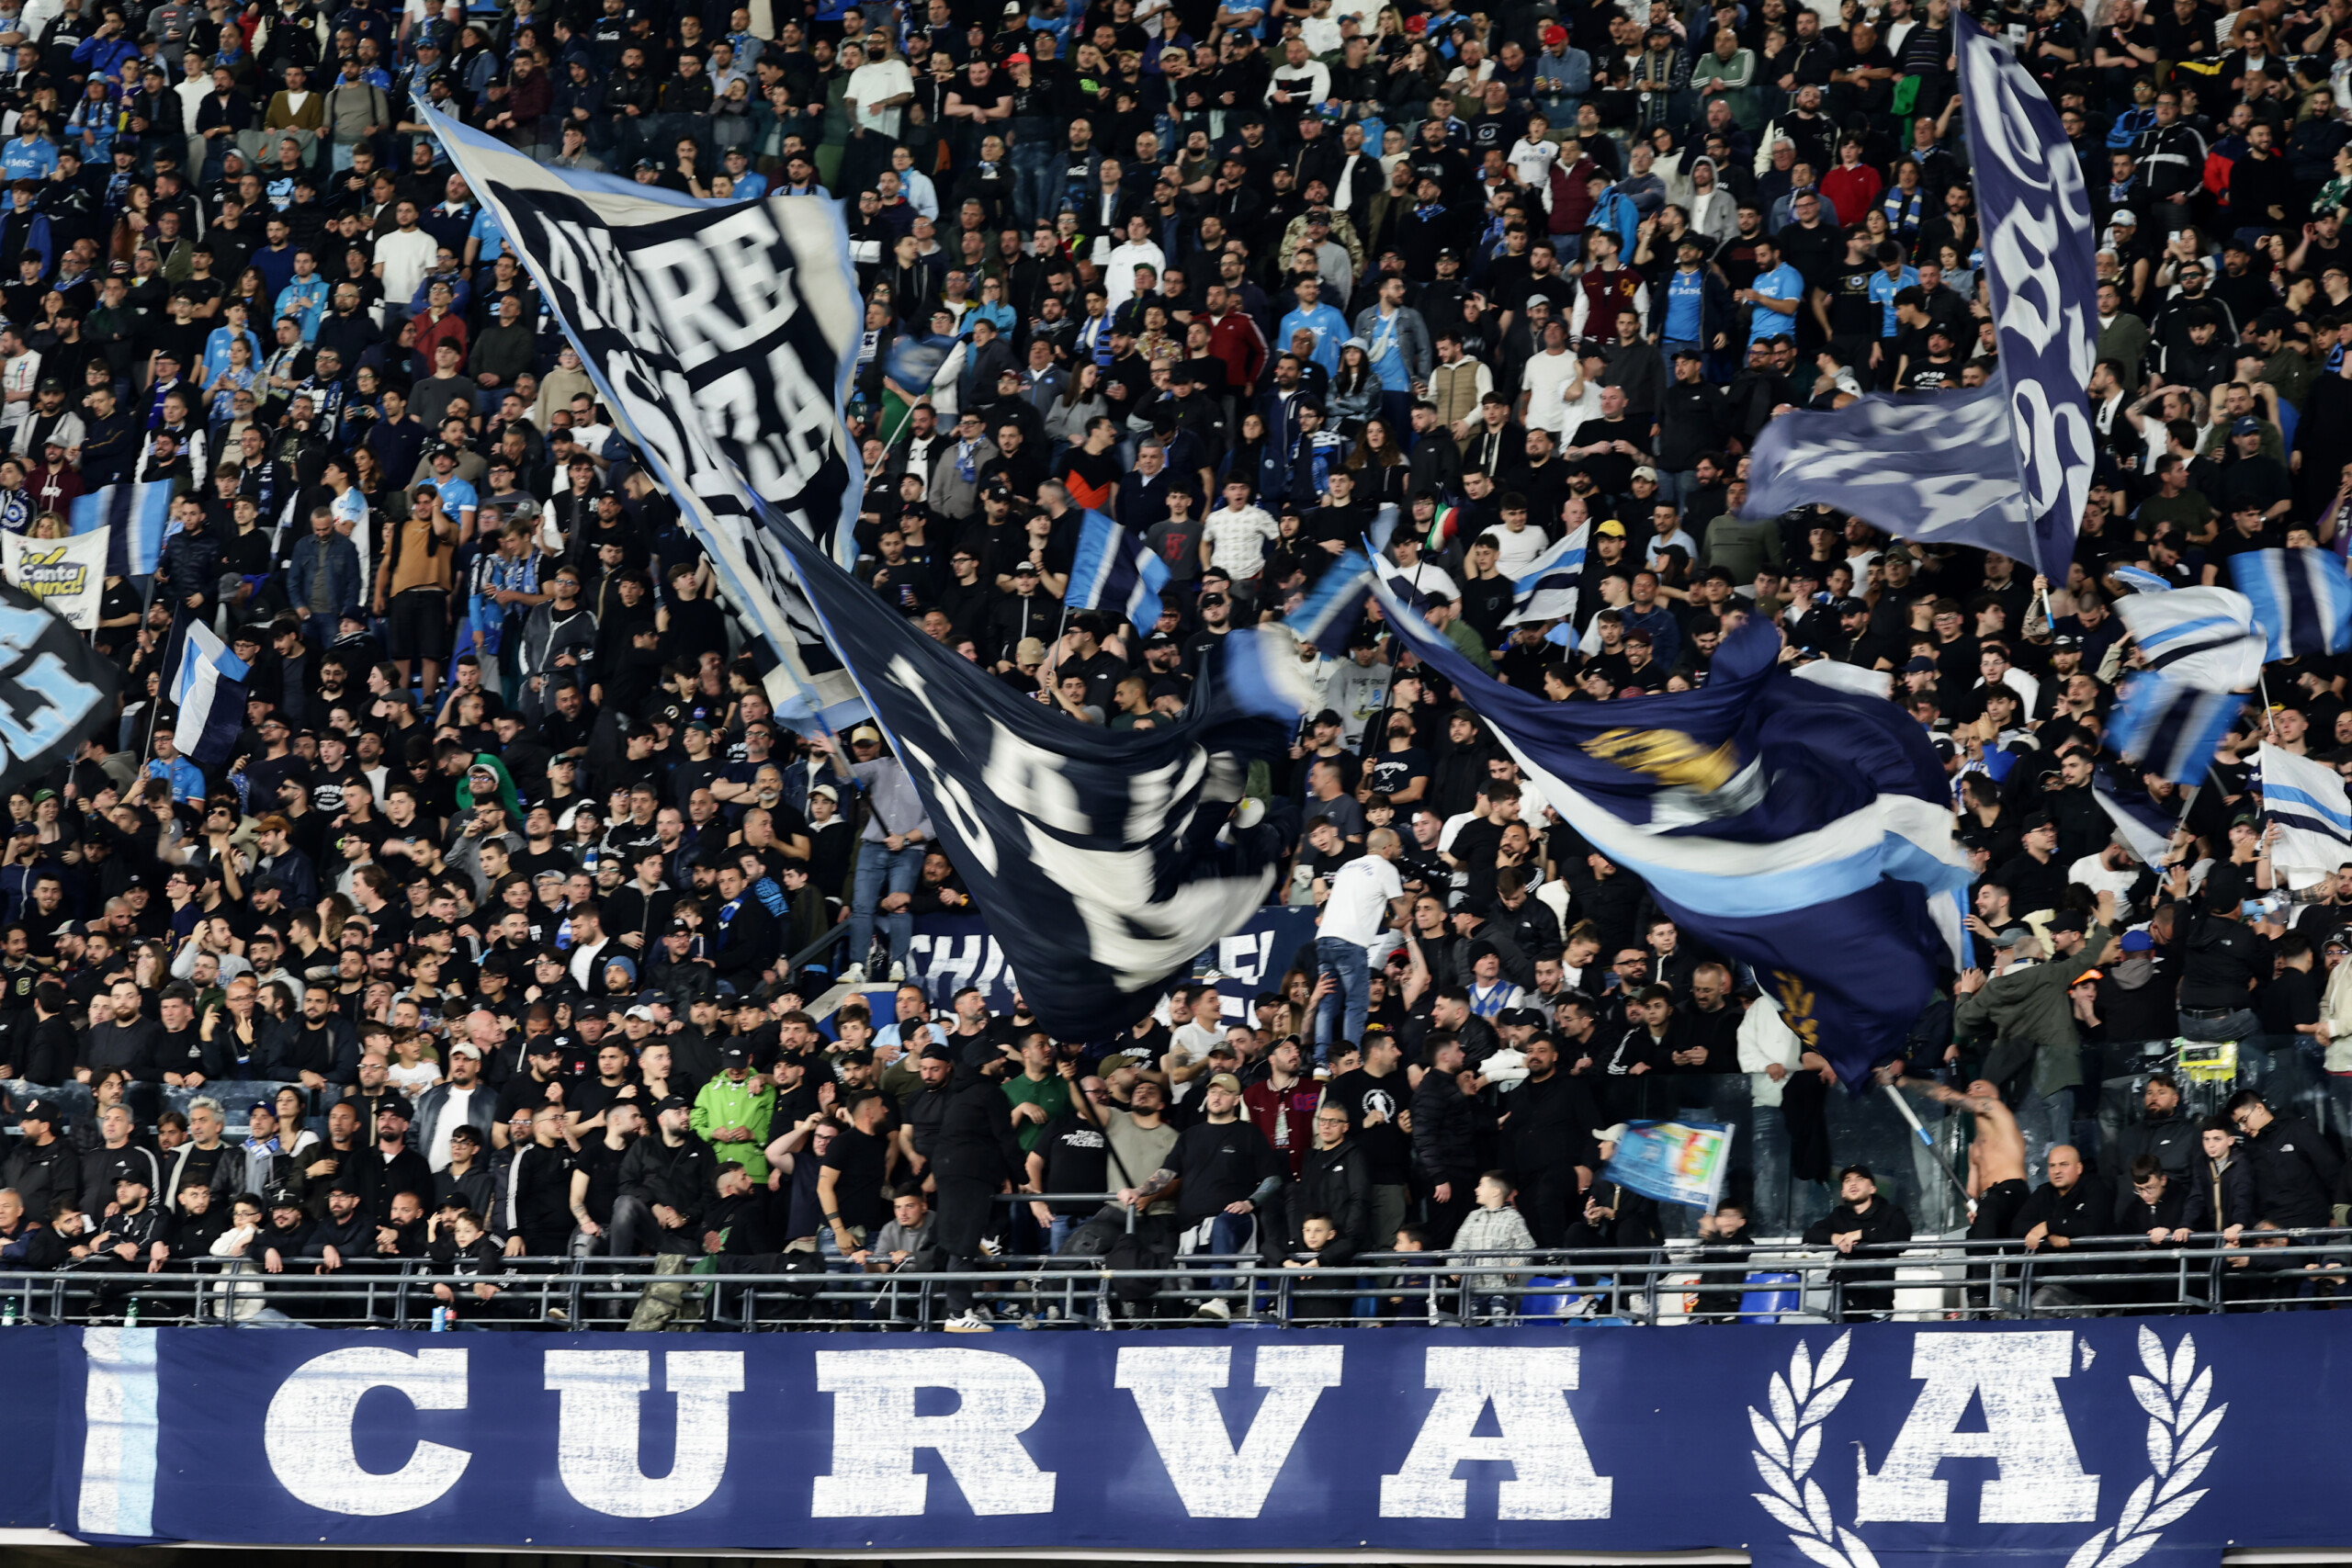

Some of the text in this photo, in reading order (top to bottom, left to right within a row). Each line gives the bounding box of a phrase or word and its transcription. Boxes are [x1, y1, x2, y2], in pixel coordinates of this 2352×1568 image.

[18, 564, 78, 581] Canta
[265, 1330, 2101, 1525] CURVA A
